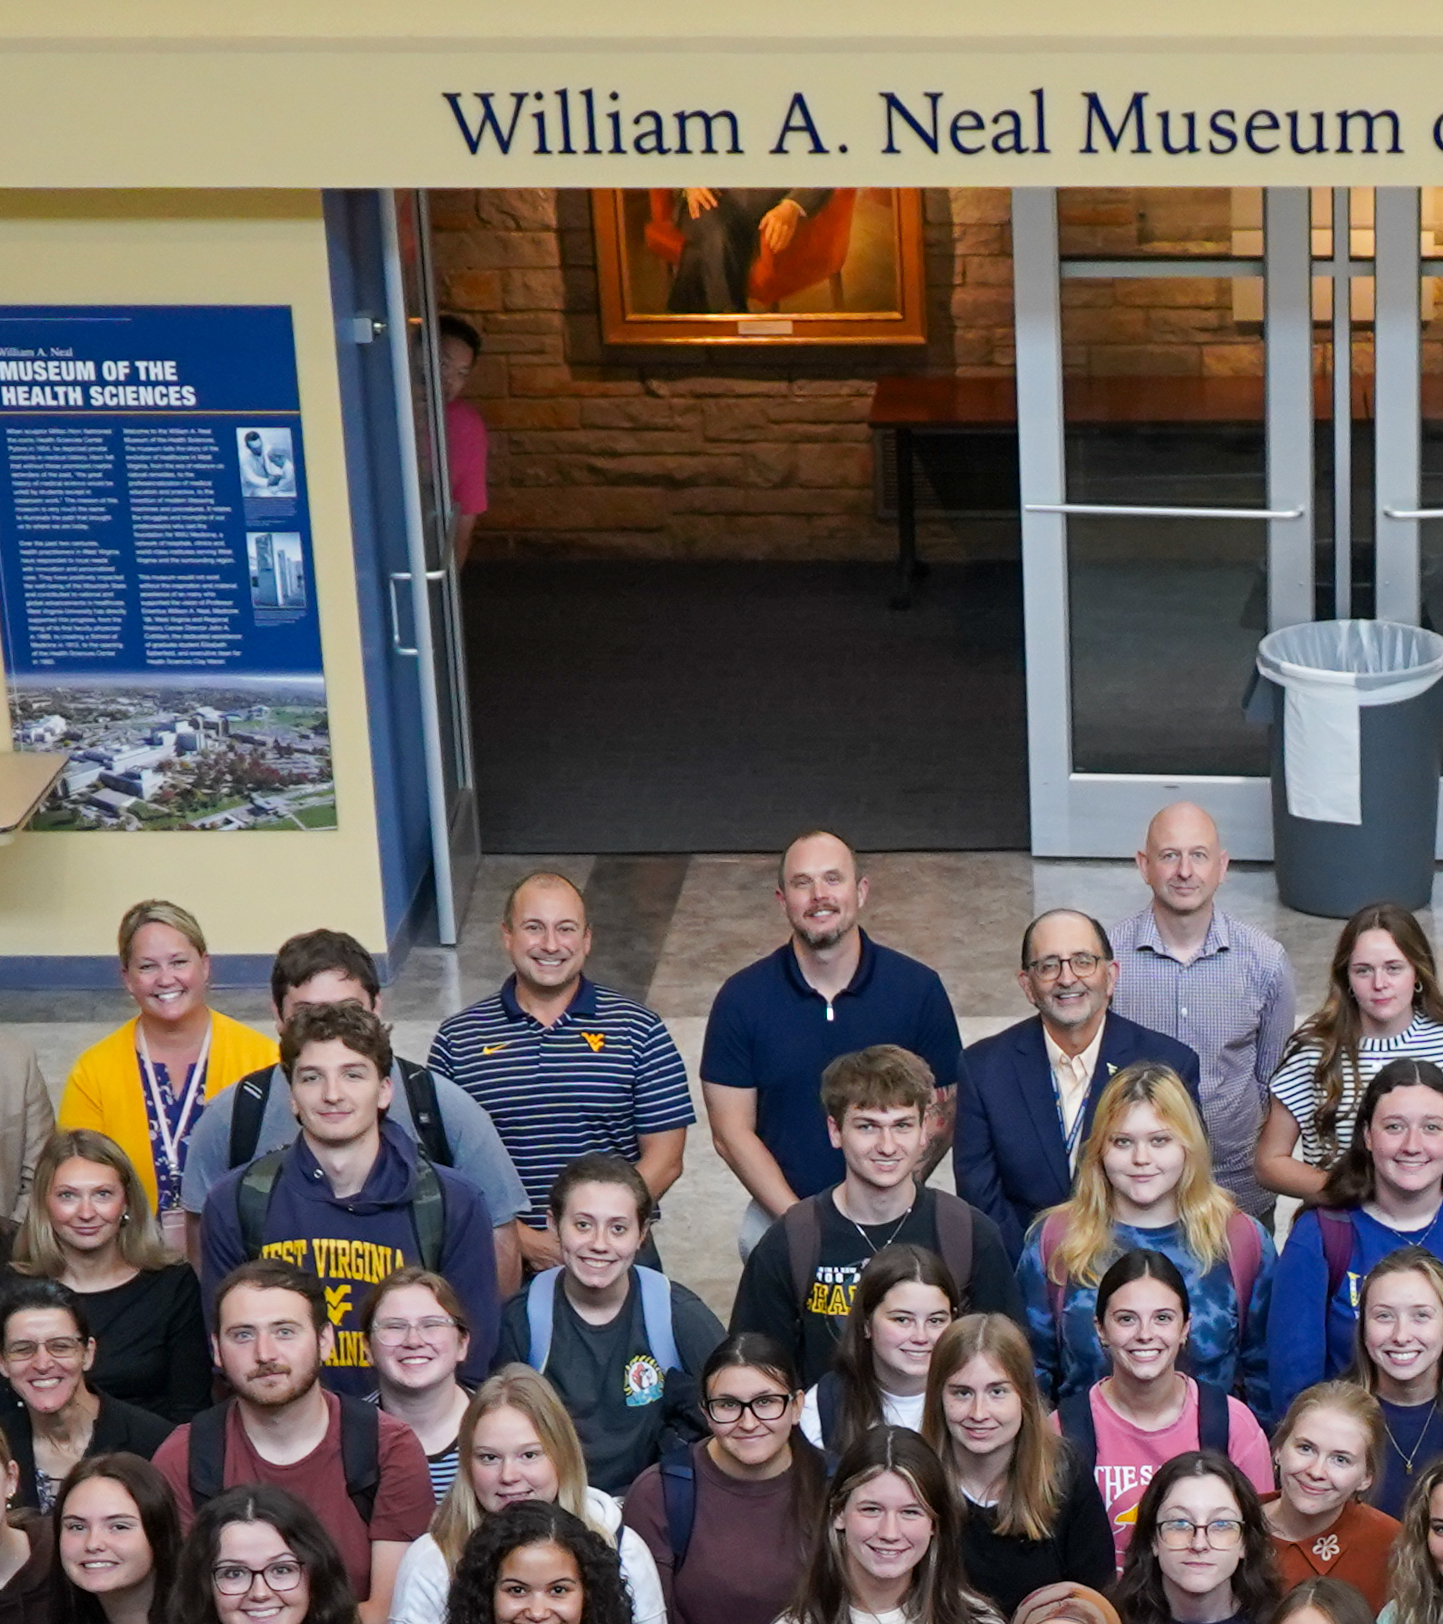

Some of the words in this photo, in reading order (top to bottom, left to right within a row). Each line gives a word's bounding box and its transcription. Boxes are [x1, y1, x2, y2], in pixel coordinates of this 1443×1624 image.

[441, 86, 746, 157] William
[768, 91, 849, 156] A.
[878, 87, 1051, 156] Neal
[1079, 90, 1404, 156] Museum
[50, 346, 74, 358] Neal
[102, 360, 131, 382] OF
[134, 360, 179, 382] THE
[1, 385, 84, 407] HEALTH
[89, 385, 198, 407] SCIENCES
[312, 1238, 406, 1285] VIRGINIA
